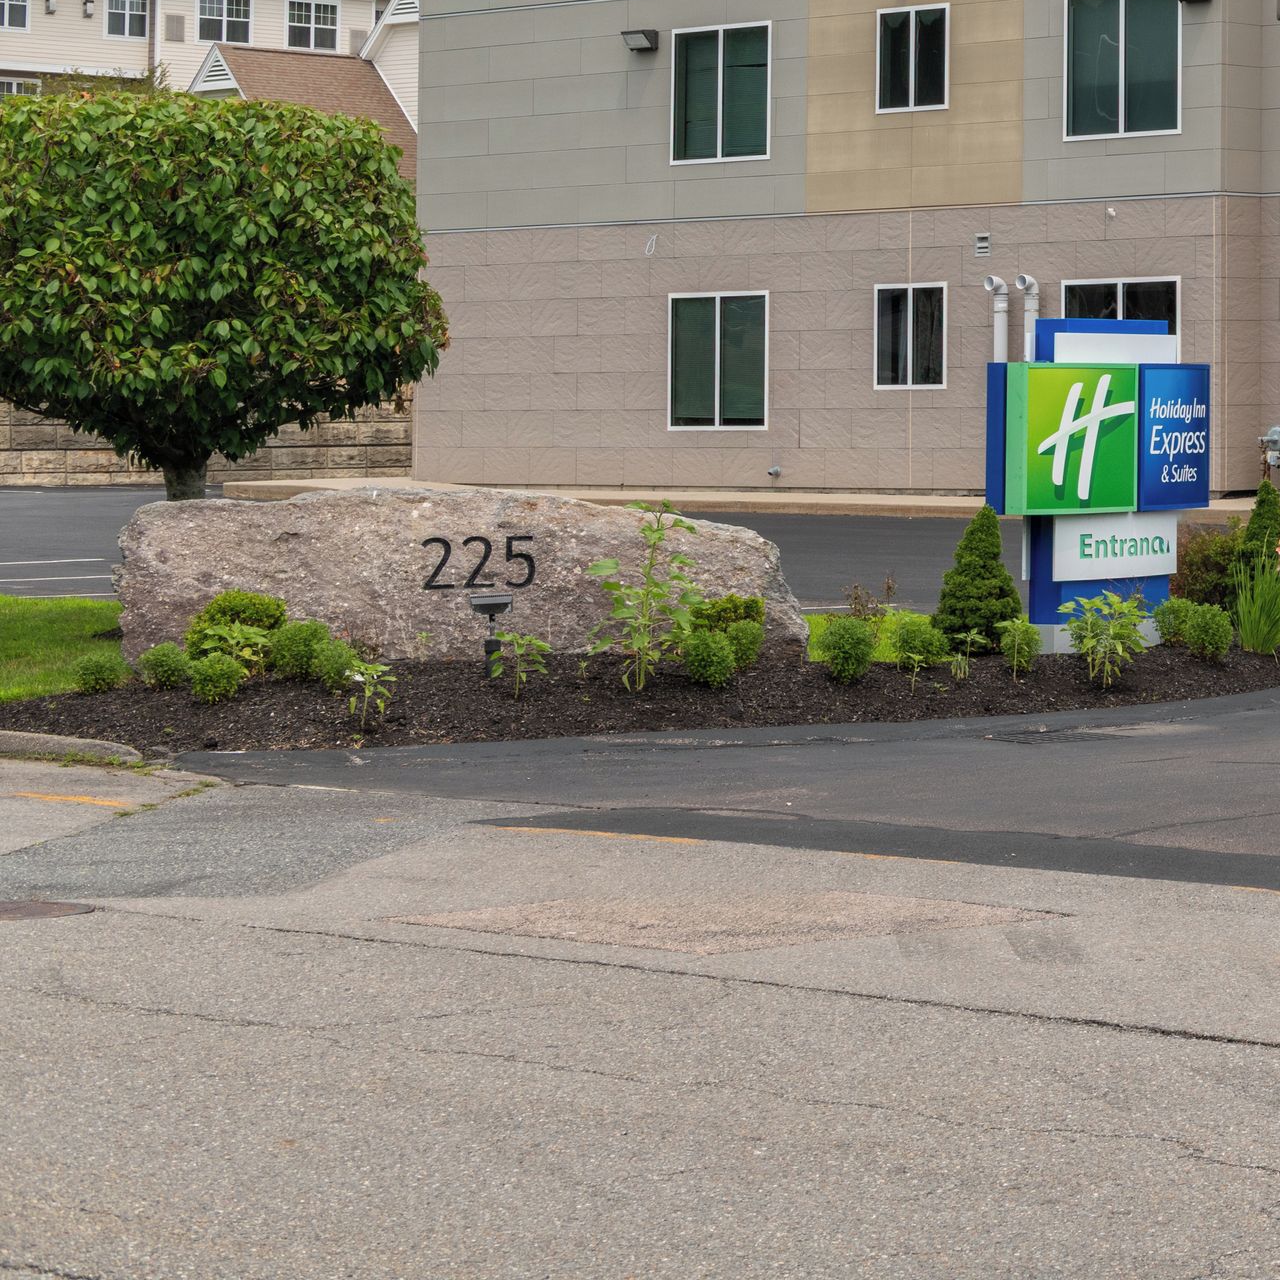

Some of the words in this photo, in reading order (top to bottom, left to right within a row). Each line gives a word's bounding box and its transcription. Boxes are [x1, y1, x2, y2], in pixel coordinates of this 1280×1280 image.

[1150, 397, 1193, 423] Holiday
[1192, 397, 1206, 418] Inn
[1037, 374, 1135, 500] H
[1150, 425, 1206, 462] Express
[1161, 464, 1170, 483] &
[1171, 464, 1197, 482] Suites
[421, 536, 536, 590] 225
